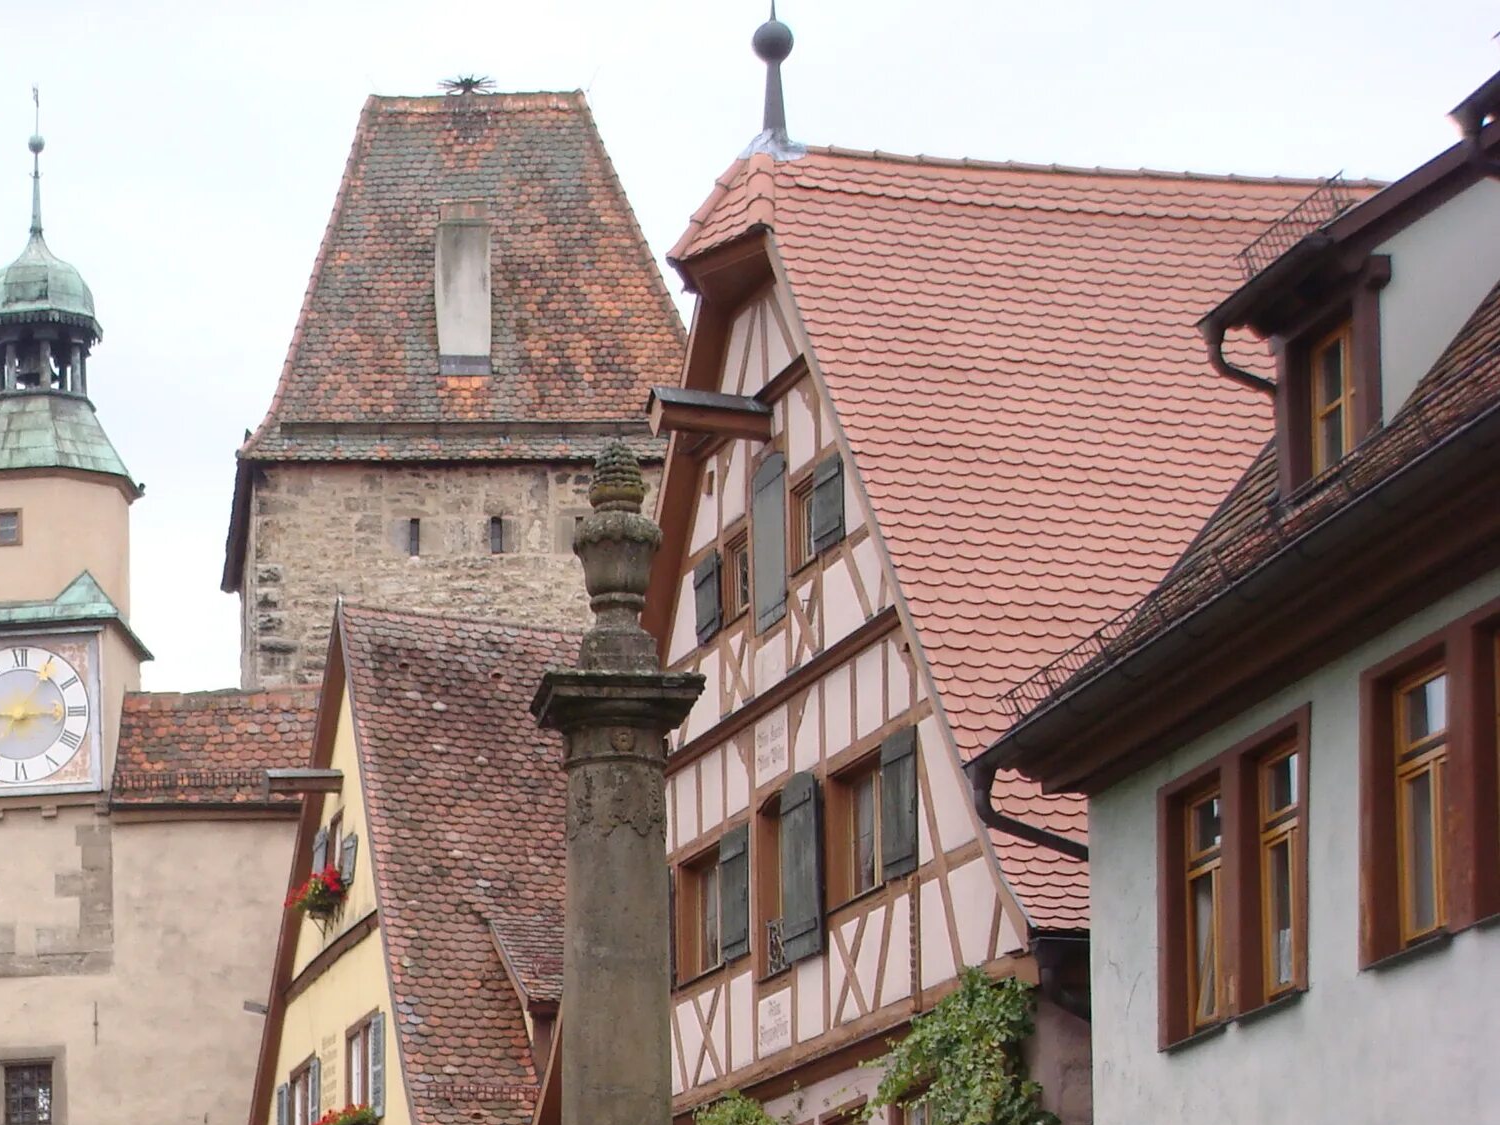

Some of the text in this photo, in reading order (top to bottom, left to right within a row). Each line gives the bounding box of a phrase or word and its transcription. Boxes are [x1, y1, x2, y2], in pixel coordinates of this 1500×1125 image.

[12, 649, 28, 668] XII
[60, 675, 79, 691] II
[67, 705, 87, 717] III
[59, 729, 82, 750] IIII
[14, 761, 29, 781] VI
[45, 754, 60, 771] V
